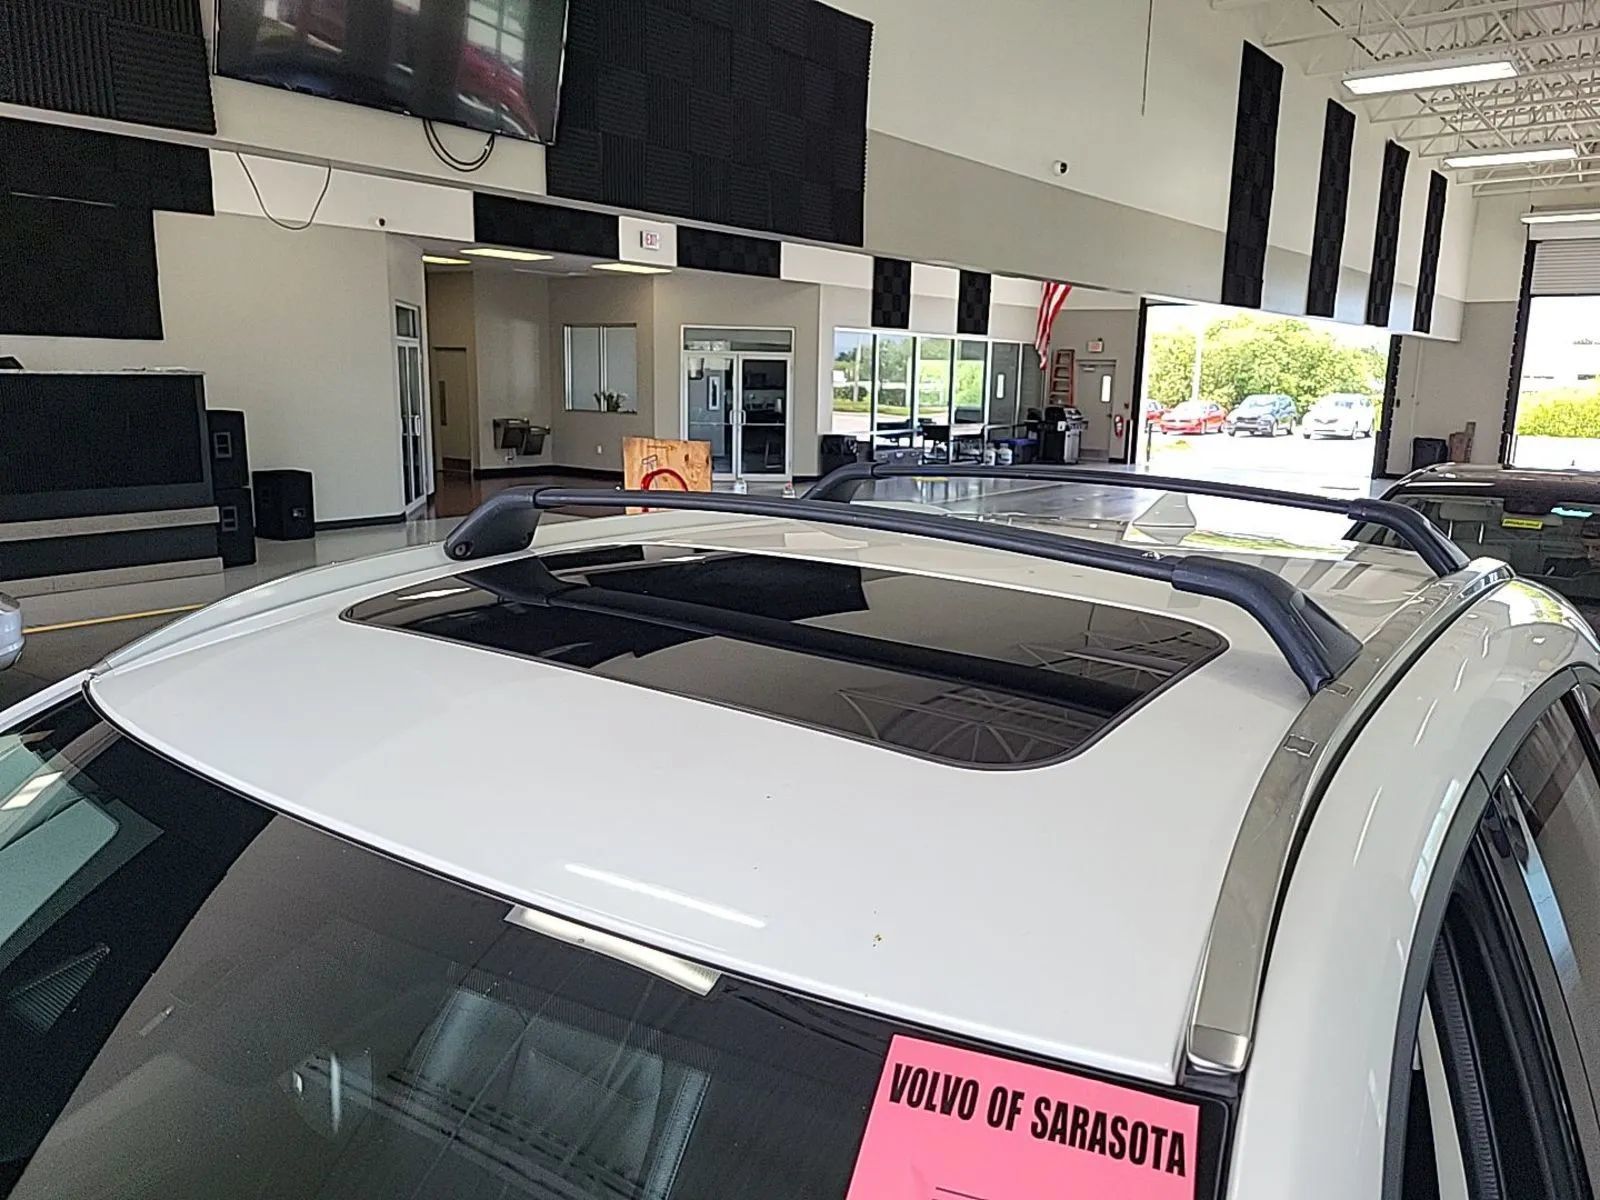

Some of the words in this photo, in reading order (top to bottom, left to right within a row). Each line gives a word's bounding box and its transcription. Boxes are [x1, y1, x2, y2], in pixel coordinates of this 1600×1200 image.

[889, 1062, 980, 1121] VOLVO
[986, 1086, 1025, 1132] OF
[1030, 1096, 1186, 1178] SARASOTA
